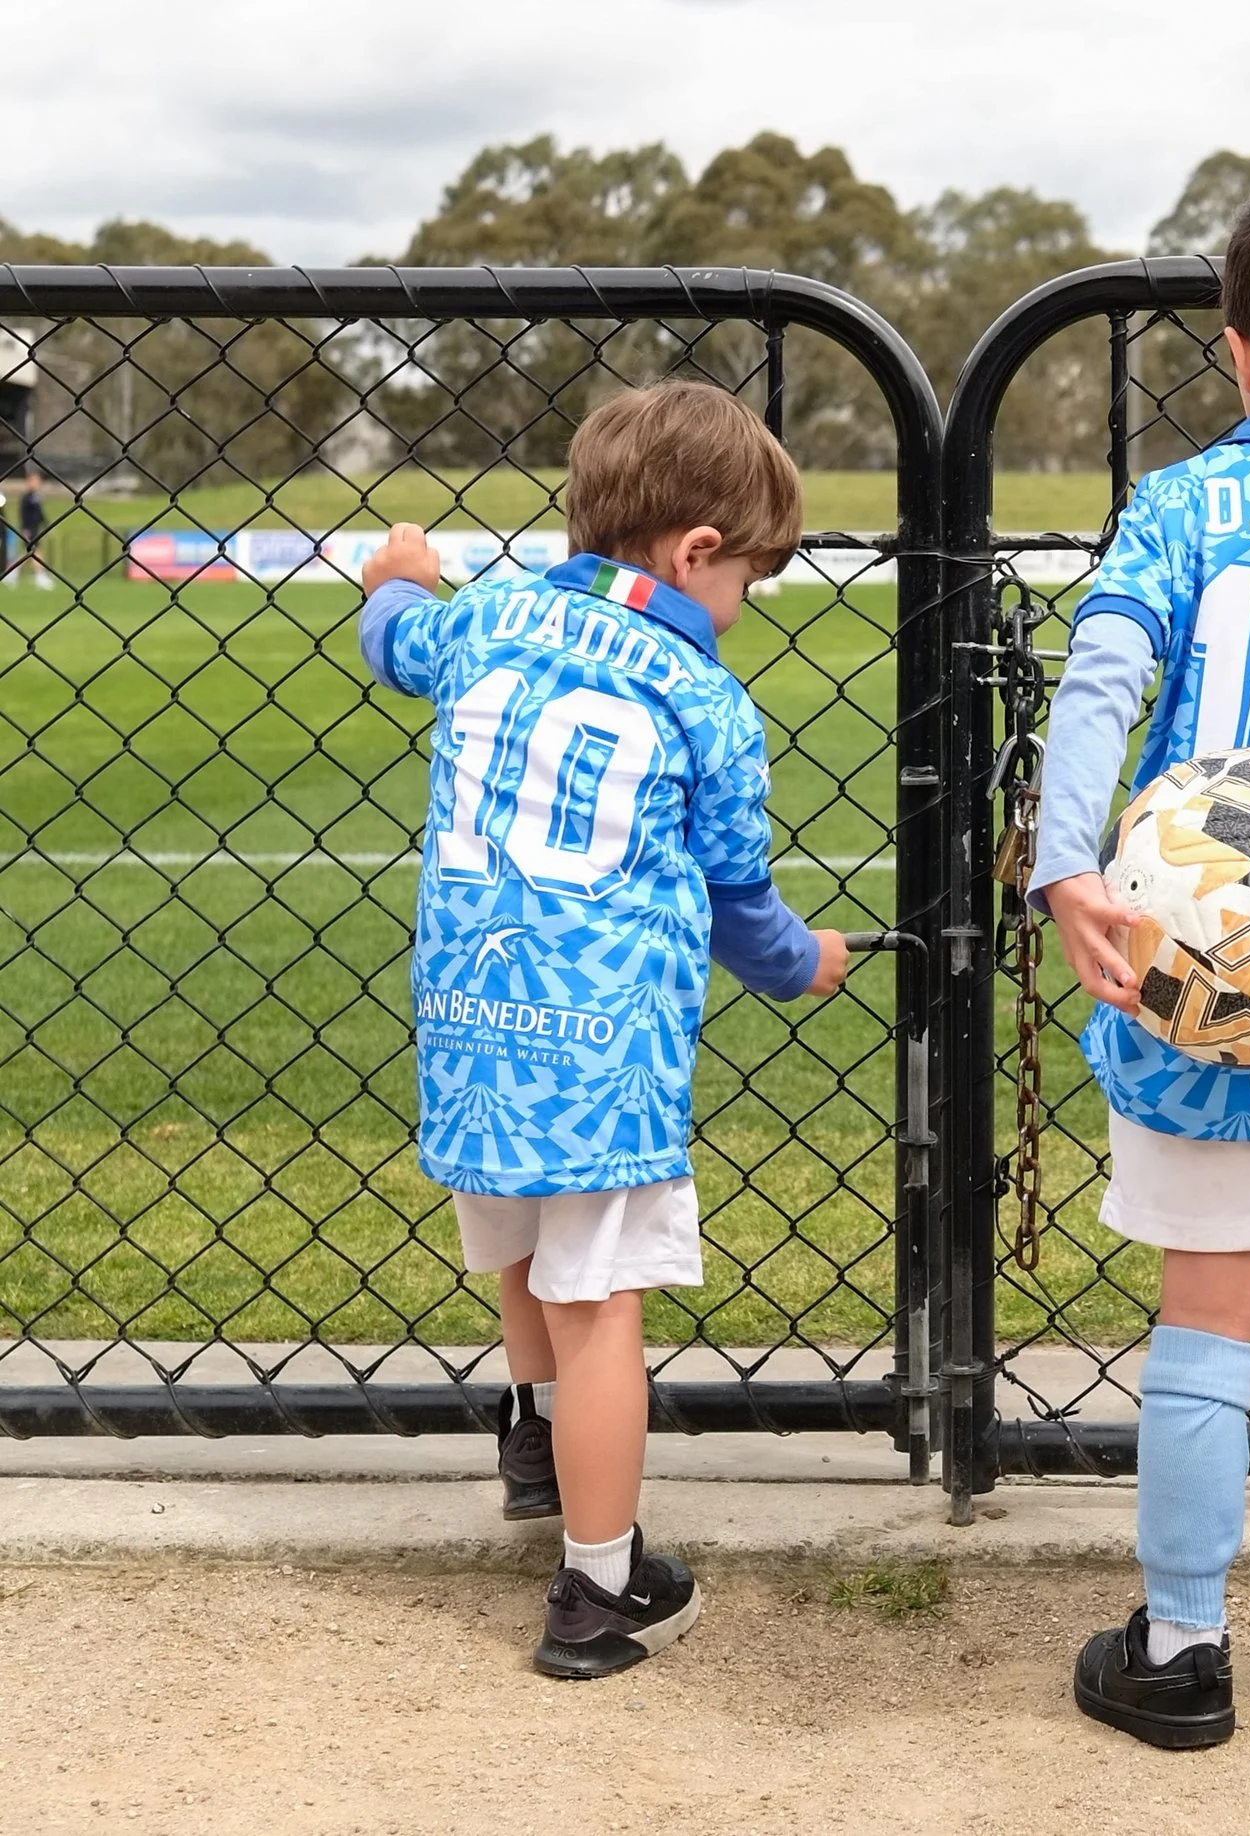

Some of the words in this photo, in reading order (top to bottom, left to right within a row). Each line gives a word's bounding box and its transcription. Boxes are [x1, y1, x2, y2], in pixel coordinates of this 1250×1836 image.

[491, 589, 695, 696] DADDY
[437, 668, 667, 902] 10
[449, 989, 614, 1045] BENEDETTO
[516, 1048, 572, 1067] WATER
